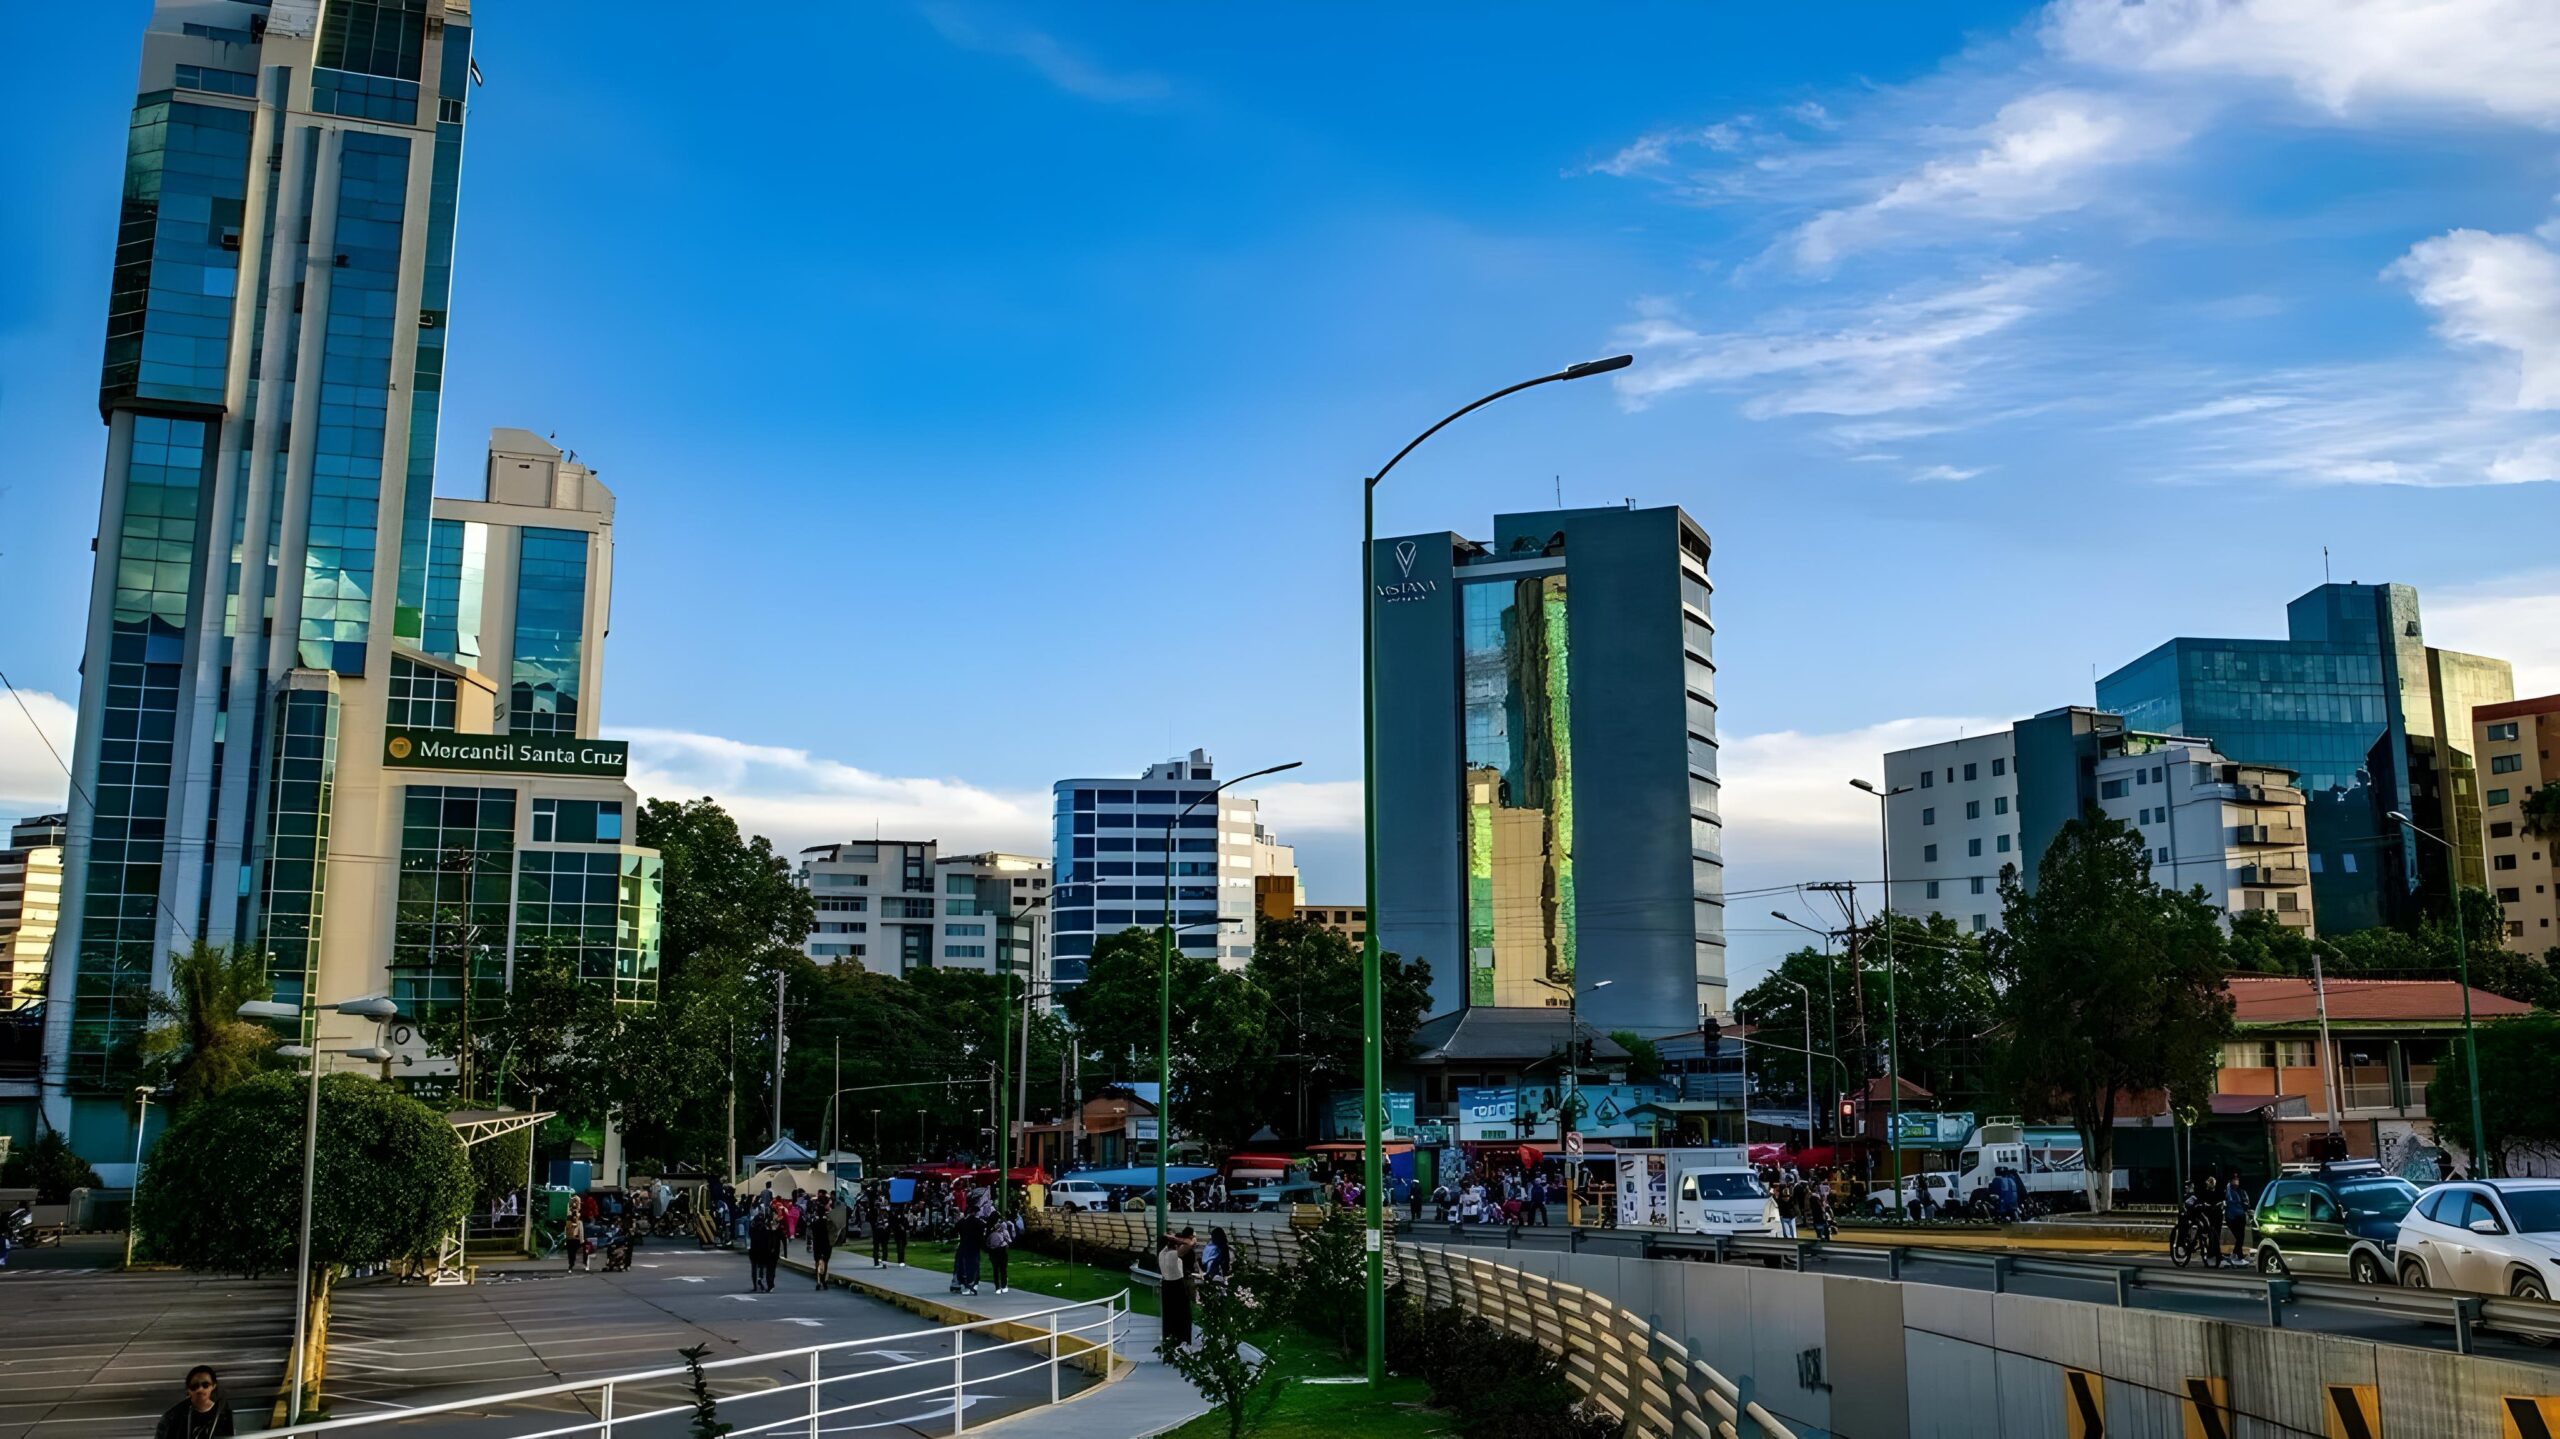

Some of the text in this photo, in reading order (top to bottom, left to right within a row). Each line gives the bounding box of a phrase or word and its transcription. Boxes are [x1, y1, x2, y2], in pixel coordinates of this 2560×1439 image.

[420, 741, 624, 766] Mercantil Santa Cruz
